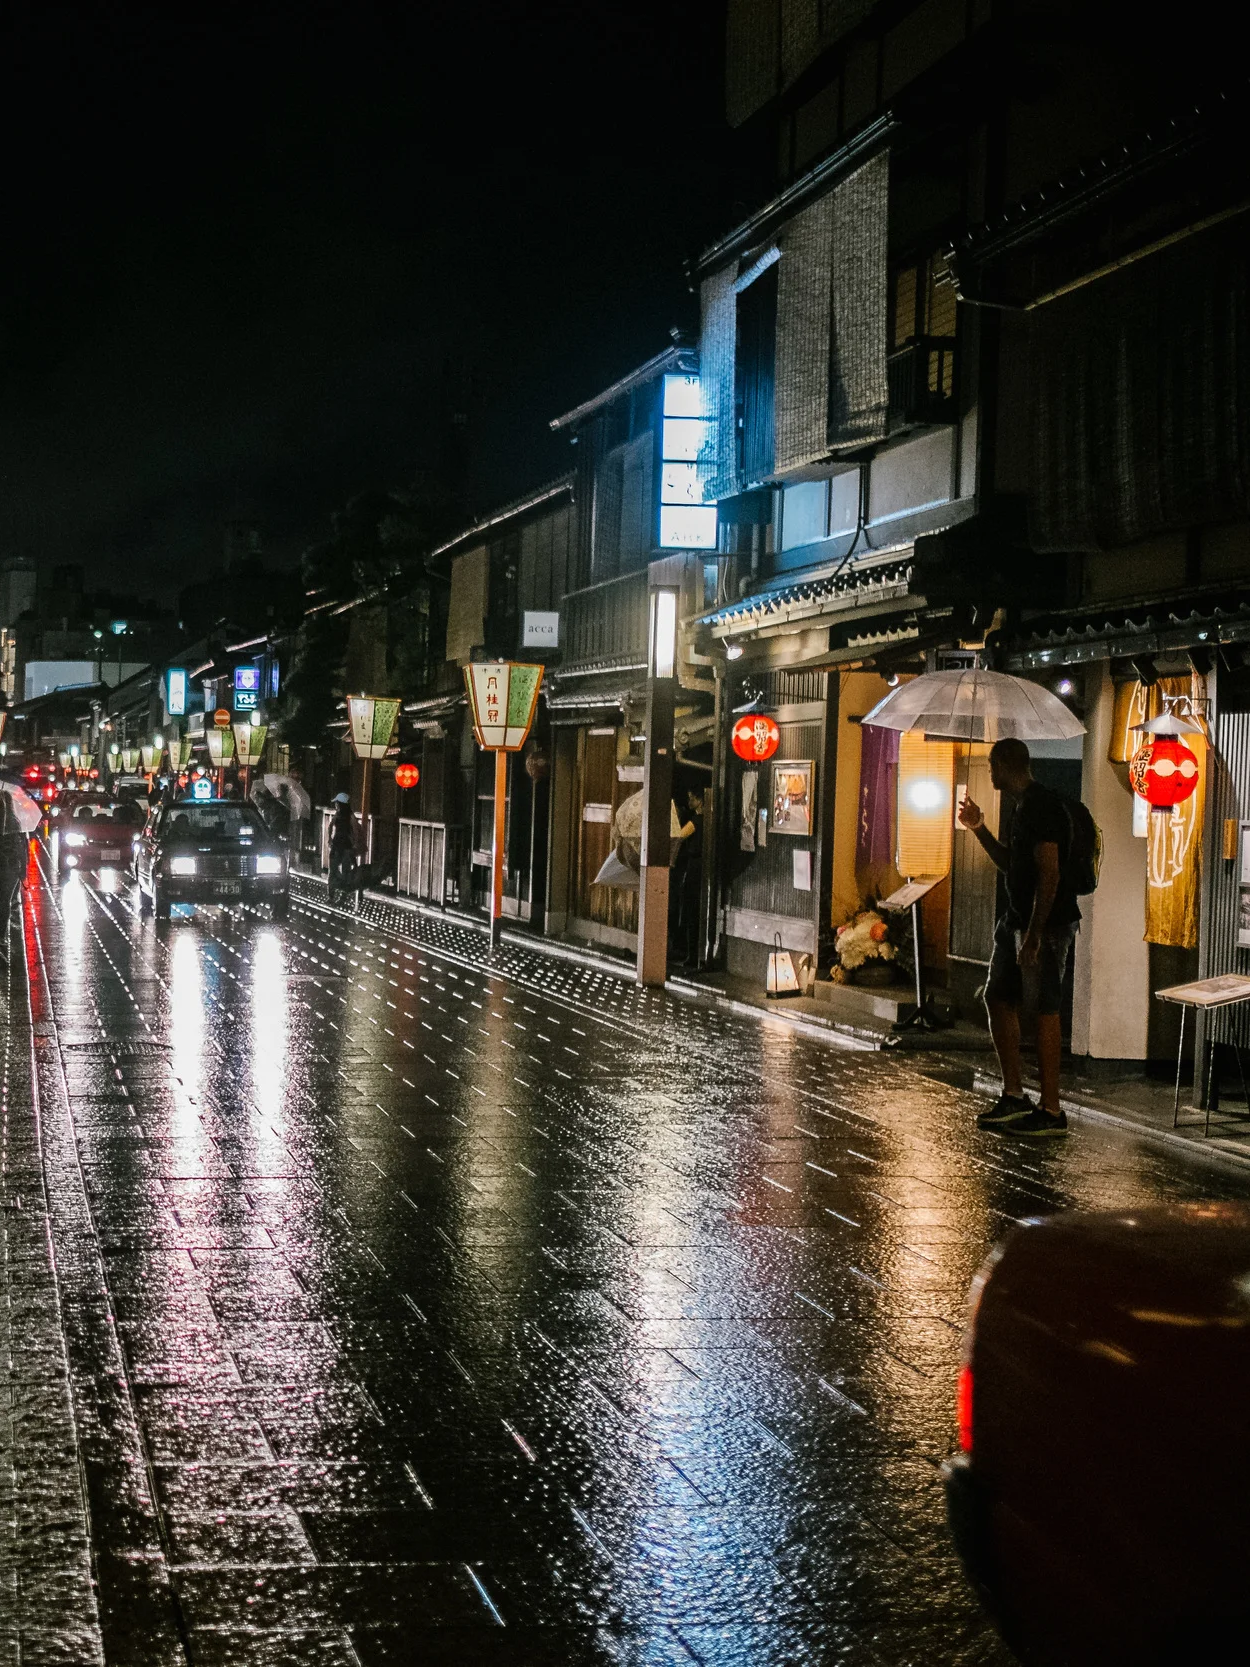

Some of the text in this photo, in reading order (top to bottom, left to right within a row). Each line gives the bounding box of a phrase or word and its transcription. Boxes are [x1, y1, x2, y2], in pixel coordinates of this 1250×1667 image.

[528, 625, 554, 634] acca
[486, 676, 499, 723] 月桂冠
